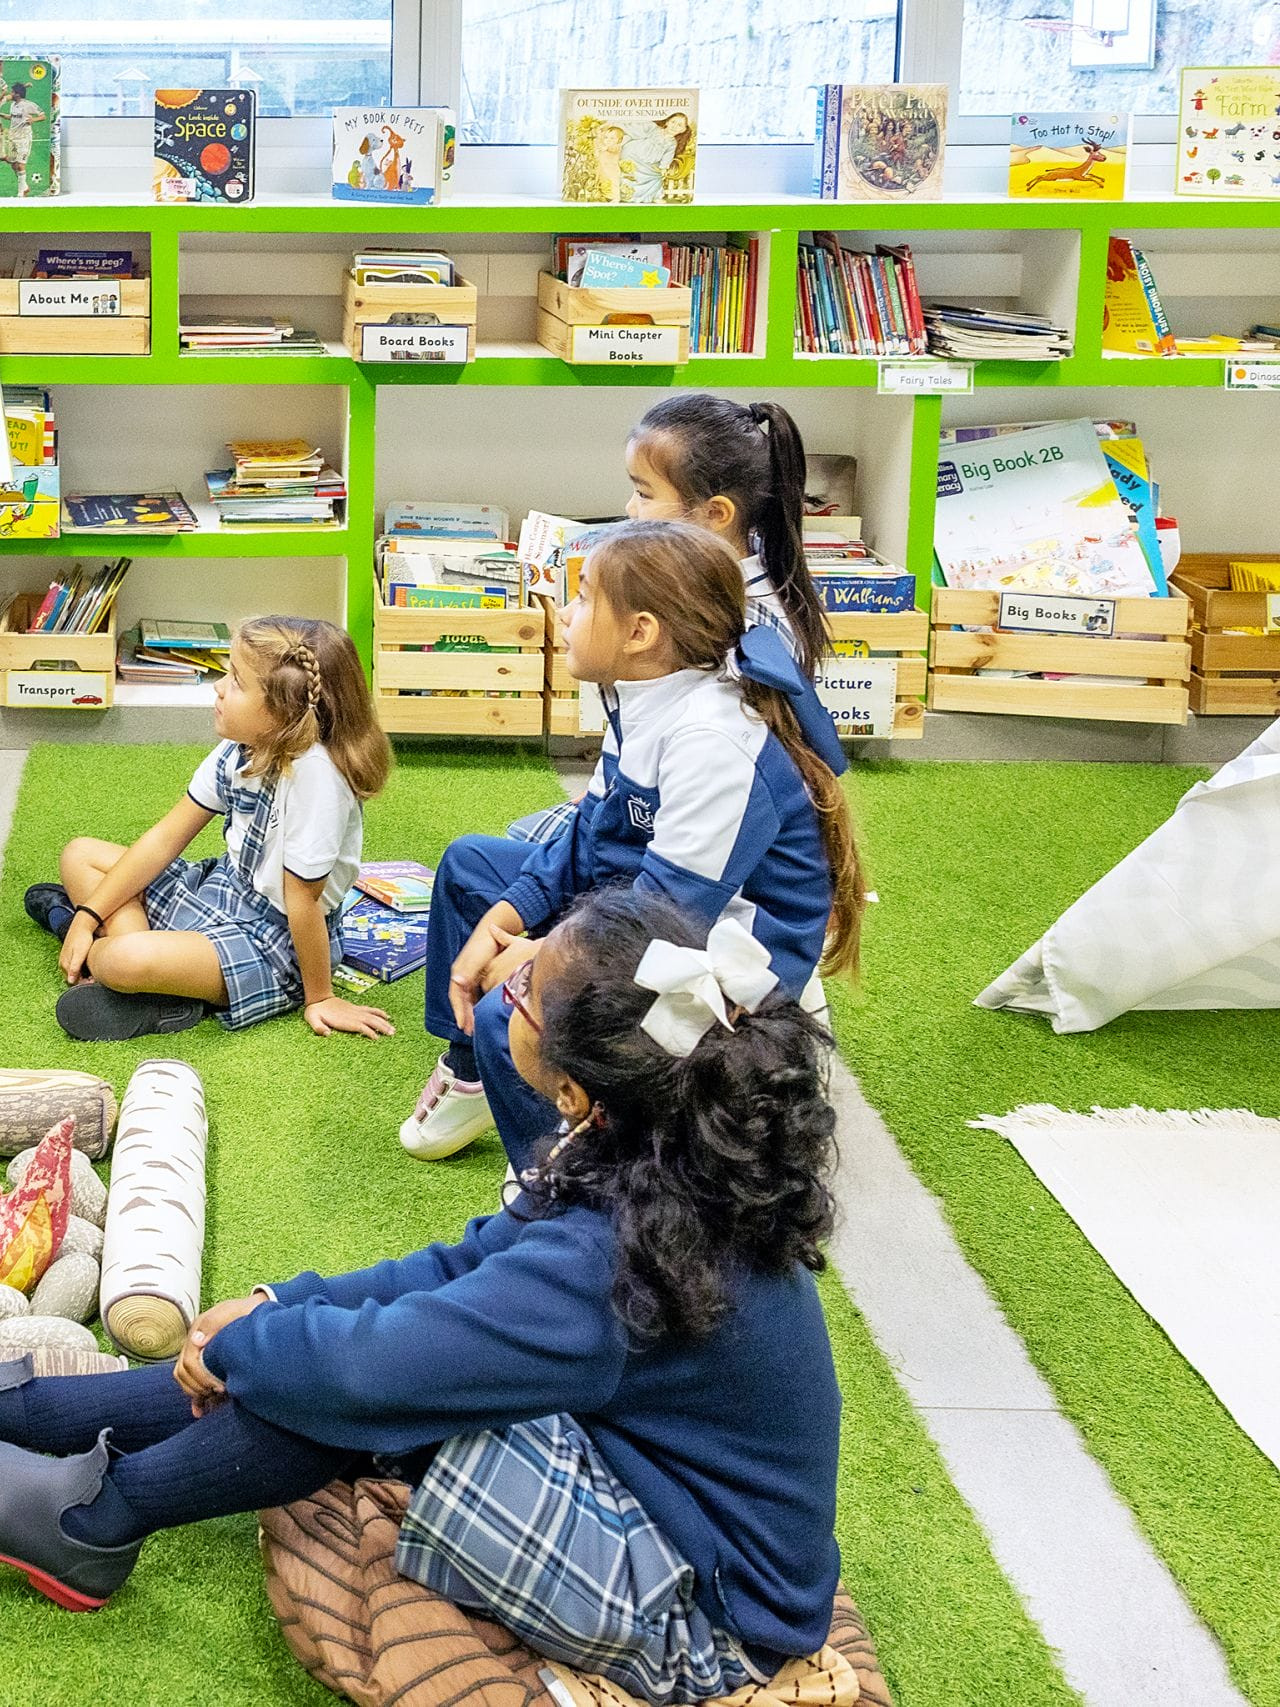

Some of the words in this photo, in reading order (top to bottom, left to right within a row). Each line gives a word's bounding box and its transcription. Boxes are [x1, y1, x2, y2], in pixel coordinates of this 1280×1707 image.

[577, 98, 621, 107] OUTSIDE
[625, 98, 652, 107] OVER
[654, 98, 690, 107] THERE
[851, 88, 895, 109] Peter
[905, 88, 938, 109] Pan
[1215, 95, 1267, 116] Farm
[597, 109, 633, 117] MAURICE
[636, 109, 668, 117] SENDAK
[885, 108, 937, 119] Wendy
[174, 116, 227, 142] Space
[345, 117, 358, 132] MY
[363, 112, 386, 124] BOOK
[390, 113, 400, 124] OF
[404, 116, 425, 135] PETS
[1029, 128, 1048, 140] Too
[1050, 124, 1070, 135] Hot
[1075, 124, 1084, 135] to
[1087, 125, 1116, 142] Stop!
[46, 257, 84, 266] Where's
[85, 258, 100, 268] my
[102, 258, 125, 268] peg?
[590, 254, 635, 273] Where's
[586, 266, 618, 281] Spot?
[28, 293, 66, 304] About
[70, 293, 89, 304] Me
[1147, 287, 1170, 334] DINOSAURS
[379, 336, 414, 346] Board
[418, 336, 455, 347] Books
[589, 330, 614, 339] Mini
[618, 330, 663, 343] Chapter
[609, 351, 643, 360] Books
[900, 375, 925, 387] Fairy
[928, 375, 953, 385] Tales
[7, 420, 27, 431] EAD
[10, 441, 29, 452] UT!
[961, 461, 991, 482] Big
[992, 449, 1039, 473] Book
[1039, 446, 1065, 464] 2B
[936, 472, 958, 483] mary
[1108, 463, 1142, 491] ady
[936, 482, 961, 493] eracy
[1119, 492, 1145, 513] ed
[833, 587, 904, 607] Walliams
[1007, 605, 1030, 621] Big
[1035, 608, 1077, 621] Books
[18, 684, 76, 699] Transport
[830, 706, 871, 720] ooks
